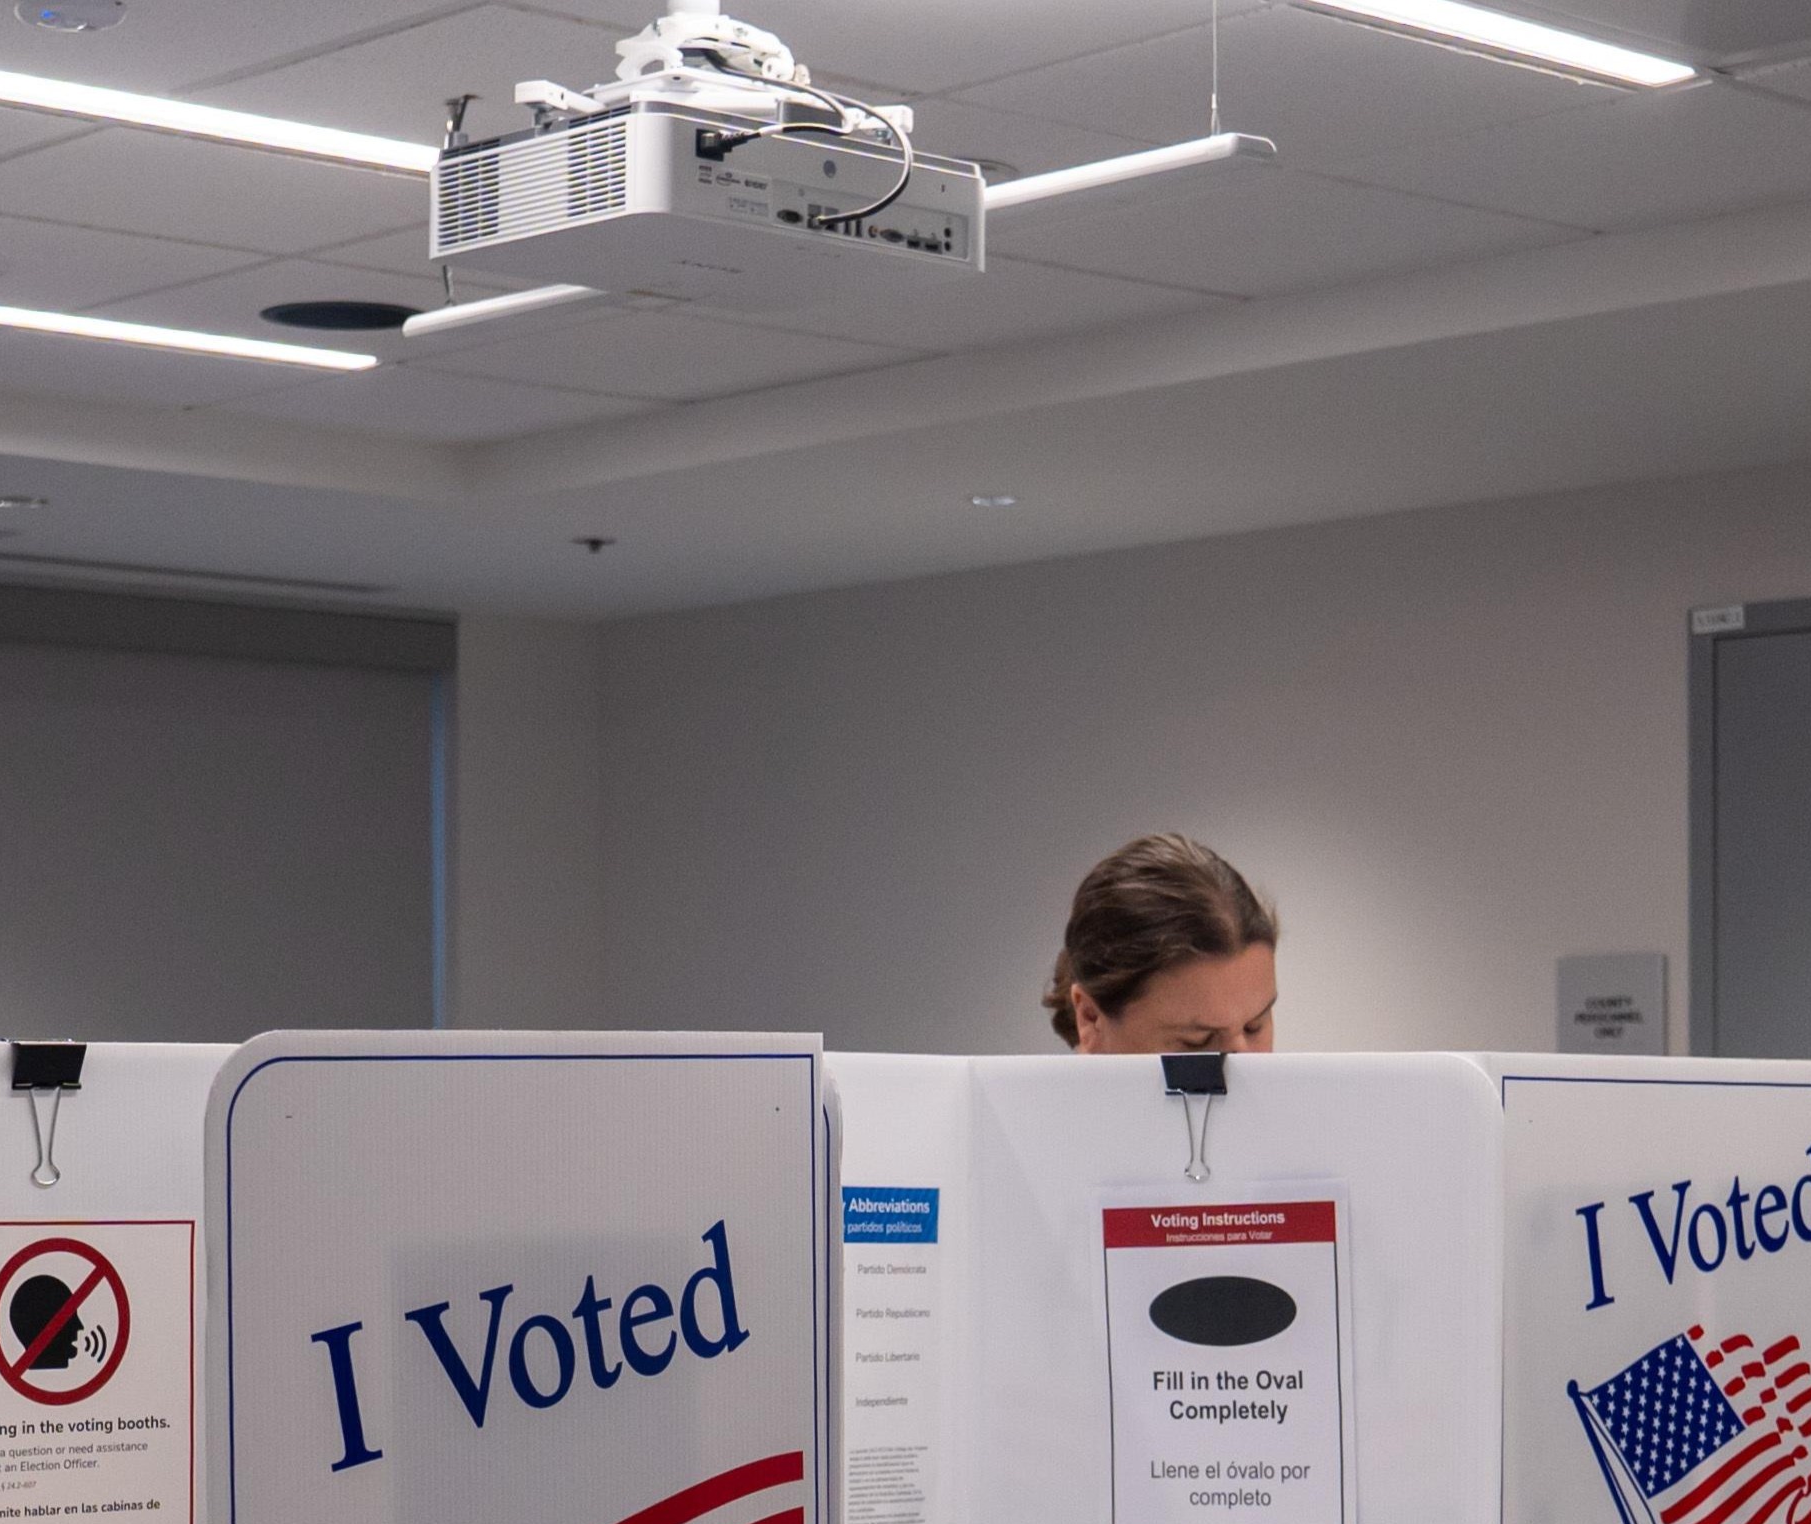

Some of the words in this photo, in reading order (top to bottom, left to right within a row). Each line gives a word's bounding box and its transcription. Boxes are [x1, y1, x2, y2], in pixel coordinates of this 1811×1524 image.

[849, 1198, 930, 1213] Abbreviations
[847, 1221, 884, 1234] partidos
[1150, 1214, 1199, 1230] Voting
[1202, 1211, 1285, 1226] Instructions
[1166, 1232, 1225, 1243] Instrucciones
[1227, 1231, 1247, 1243] para
[1248, 1230, 1273, 1240] Votar
[1576, 1202, 1615, 1311] I
[857, 1264, 885, 1274] Partido
[856, 1308, 884, 1318] Partido
[311, 1321, 384, 1472] I
[404, 1219, 751, 1429] Voted
[855, 1352, 884, 1363] Partido
[1153, 1371, 1184, 1390] Fill
[1191, 1371, 1209, 1390] in
[1216, 1370, 1249, 1390] the
[1256, 1370, 1303, 1389] Oval
[1169, 1400, 1288, 1425] Completely
[22, 1420, 35, 1434] in
[40, 1419, 64, 1434] the
[68, 1417, 113, 1434] voting
[117, 1415, 171, 1431] booths.
[0, 1449, 6, 1458] a
[8, 1445, 53, 1459] question
[55, 1446, 66, 1455] or
[68, 1443, 94, 1454] need
[96, 1441, 149, 1454] assistance
[4, 1463, 17, 1472] an
[20, 1458, 61, 1472] Election
[63, 1457, 99, 1469] Officer.
[1151, 1460, 1199, 1479] Llene
[1205, 1461, 1220, 1479] el
[1227, 1461, 1275, 1479] óvalo
[1280, 1464, 1310, 1484] por
[24, 1504, 60, 1517] hablar
[64, 1504, 78, 1514] en
[81, 1502, 98, 1514] las
[101, 1499, 143, 1513] cabinas
[146, 1498, 161, 1510] de
[1189, 1488, 1272, 1510] completo
